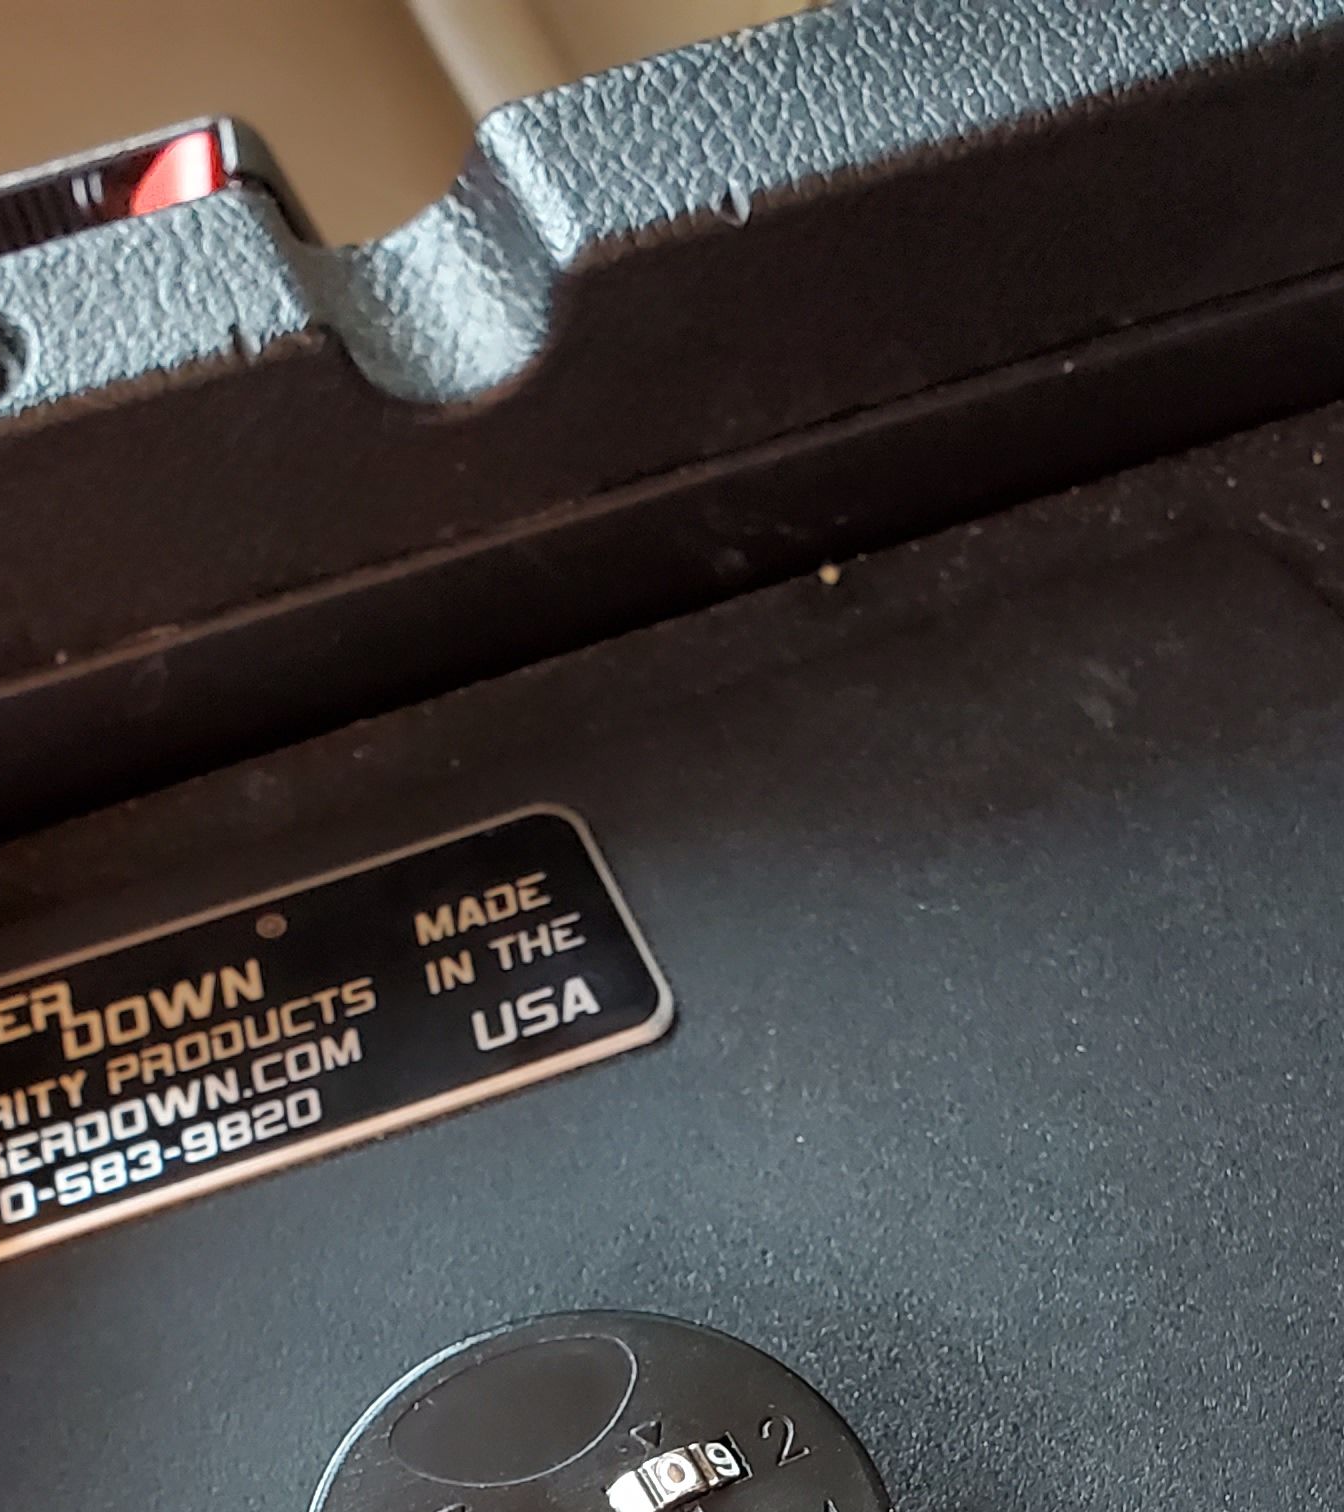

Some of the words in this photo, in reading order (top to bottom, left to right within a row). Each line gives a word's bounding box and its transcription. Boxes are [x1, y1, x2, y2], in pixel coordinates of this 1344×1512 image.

[414, 871, 552, 946] MADE
[425, 949, 476, 995] IN
[488, 911, 587, 971] THE
[60, 957, 265, 1062] DOWN
[106, 976, 377, 1095] PRODUCTS
[471, 975, 602, 1052] USA
[760, 1415, 812, 1468] 2
